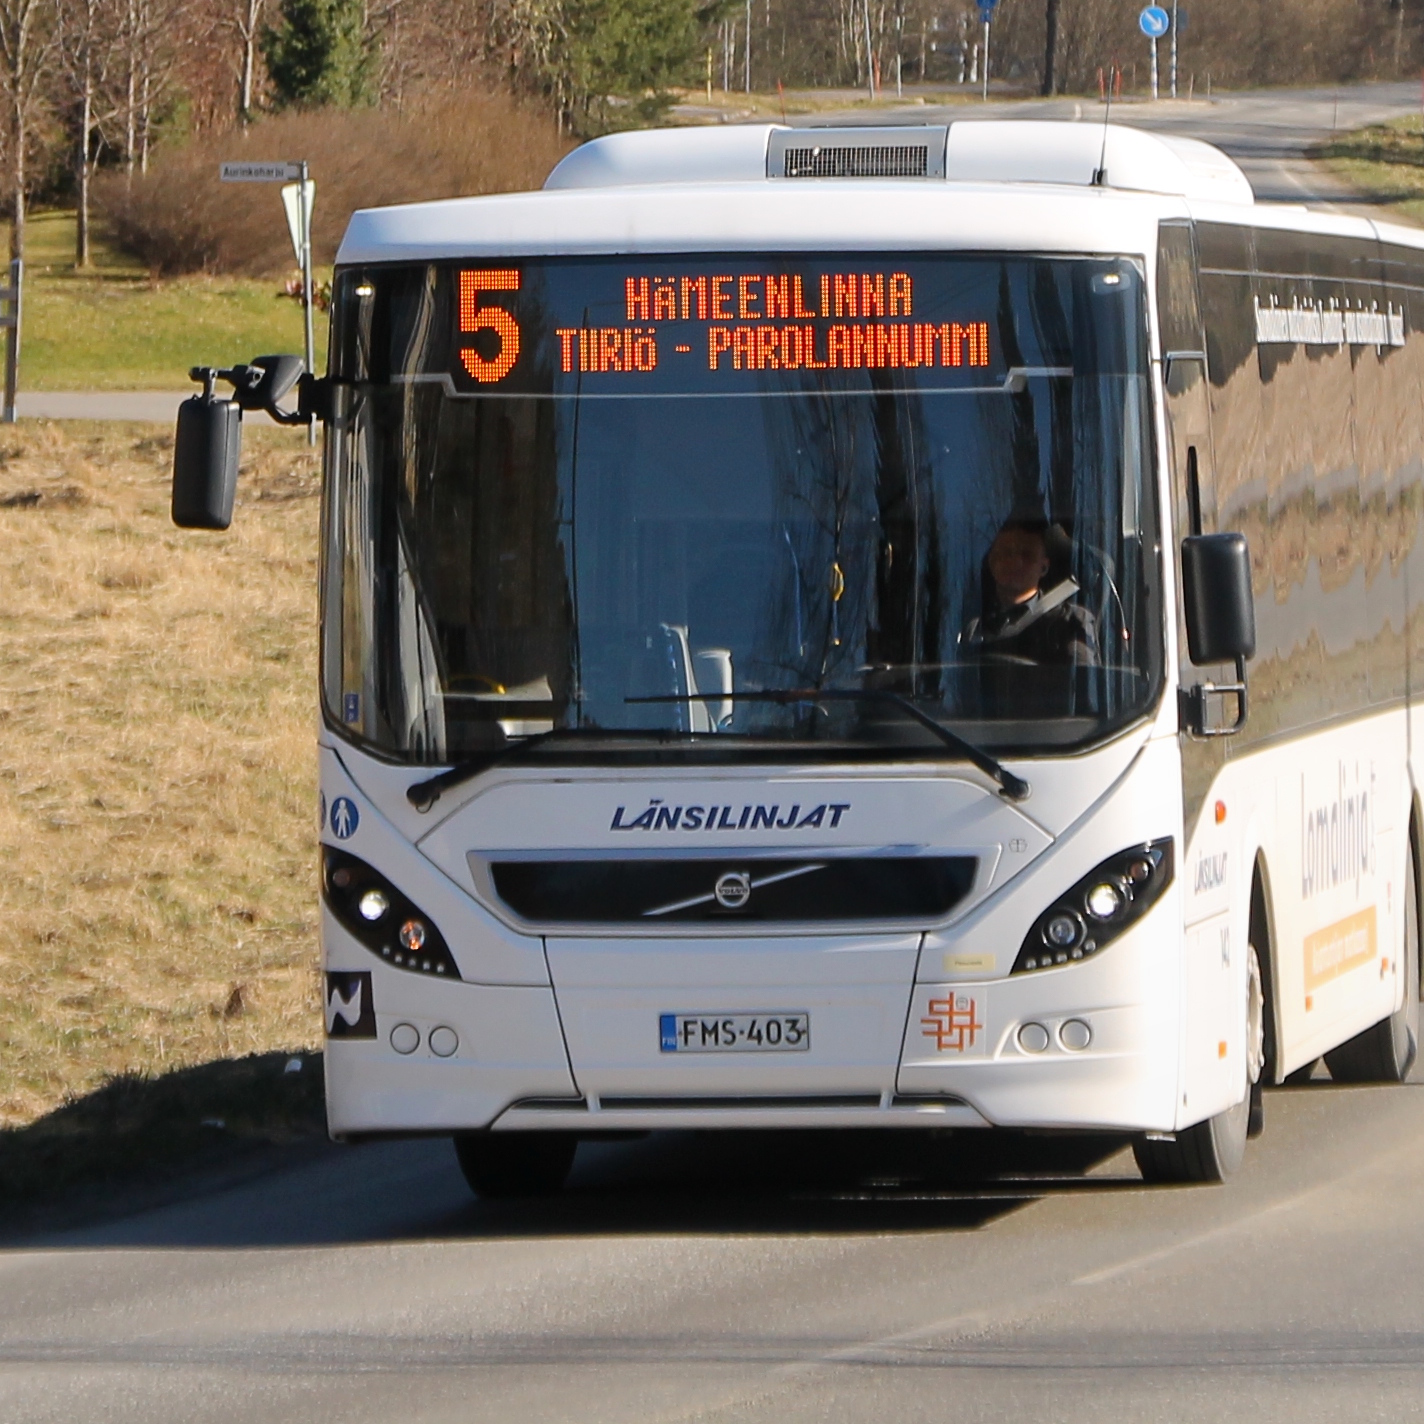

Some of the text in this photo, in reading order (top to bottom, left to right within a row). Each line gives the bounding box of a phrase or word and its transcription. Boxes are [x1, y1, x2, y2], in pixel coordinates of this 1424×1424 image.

[625, 272, 913, 321] HÄMEENLINNA
[460, 269, 521, 383] 5
[556, 327, 658, 373] TIIRIÖ
[708, 322, 989, 370] PAROLANNUMMI
[610, 799, 851, 831] LÄNSILINJAT
[718, 887, 749, 895] VOLVO
[682, 1019, 802, 1047] FMS-403
